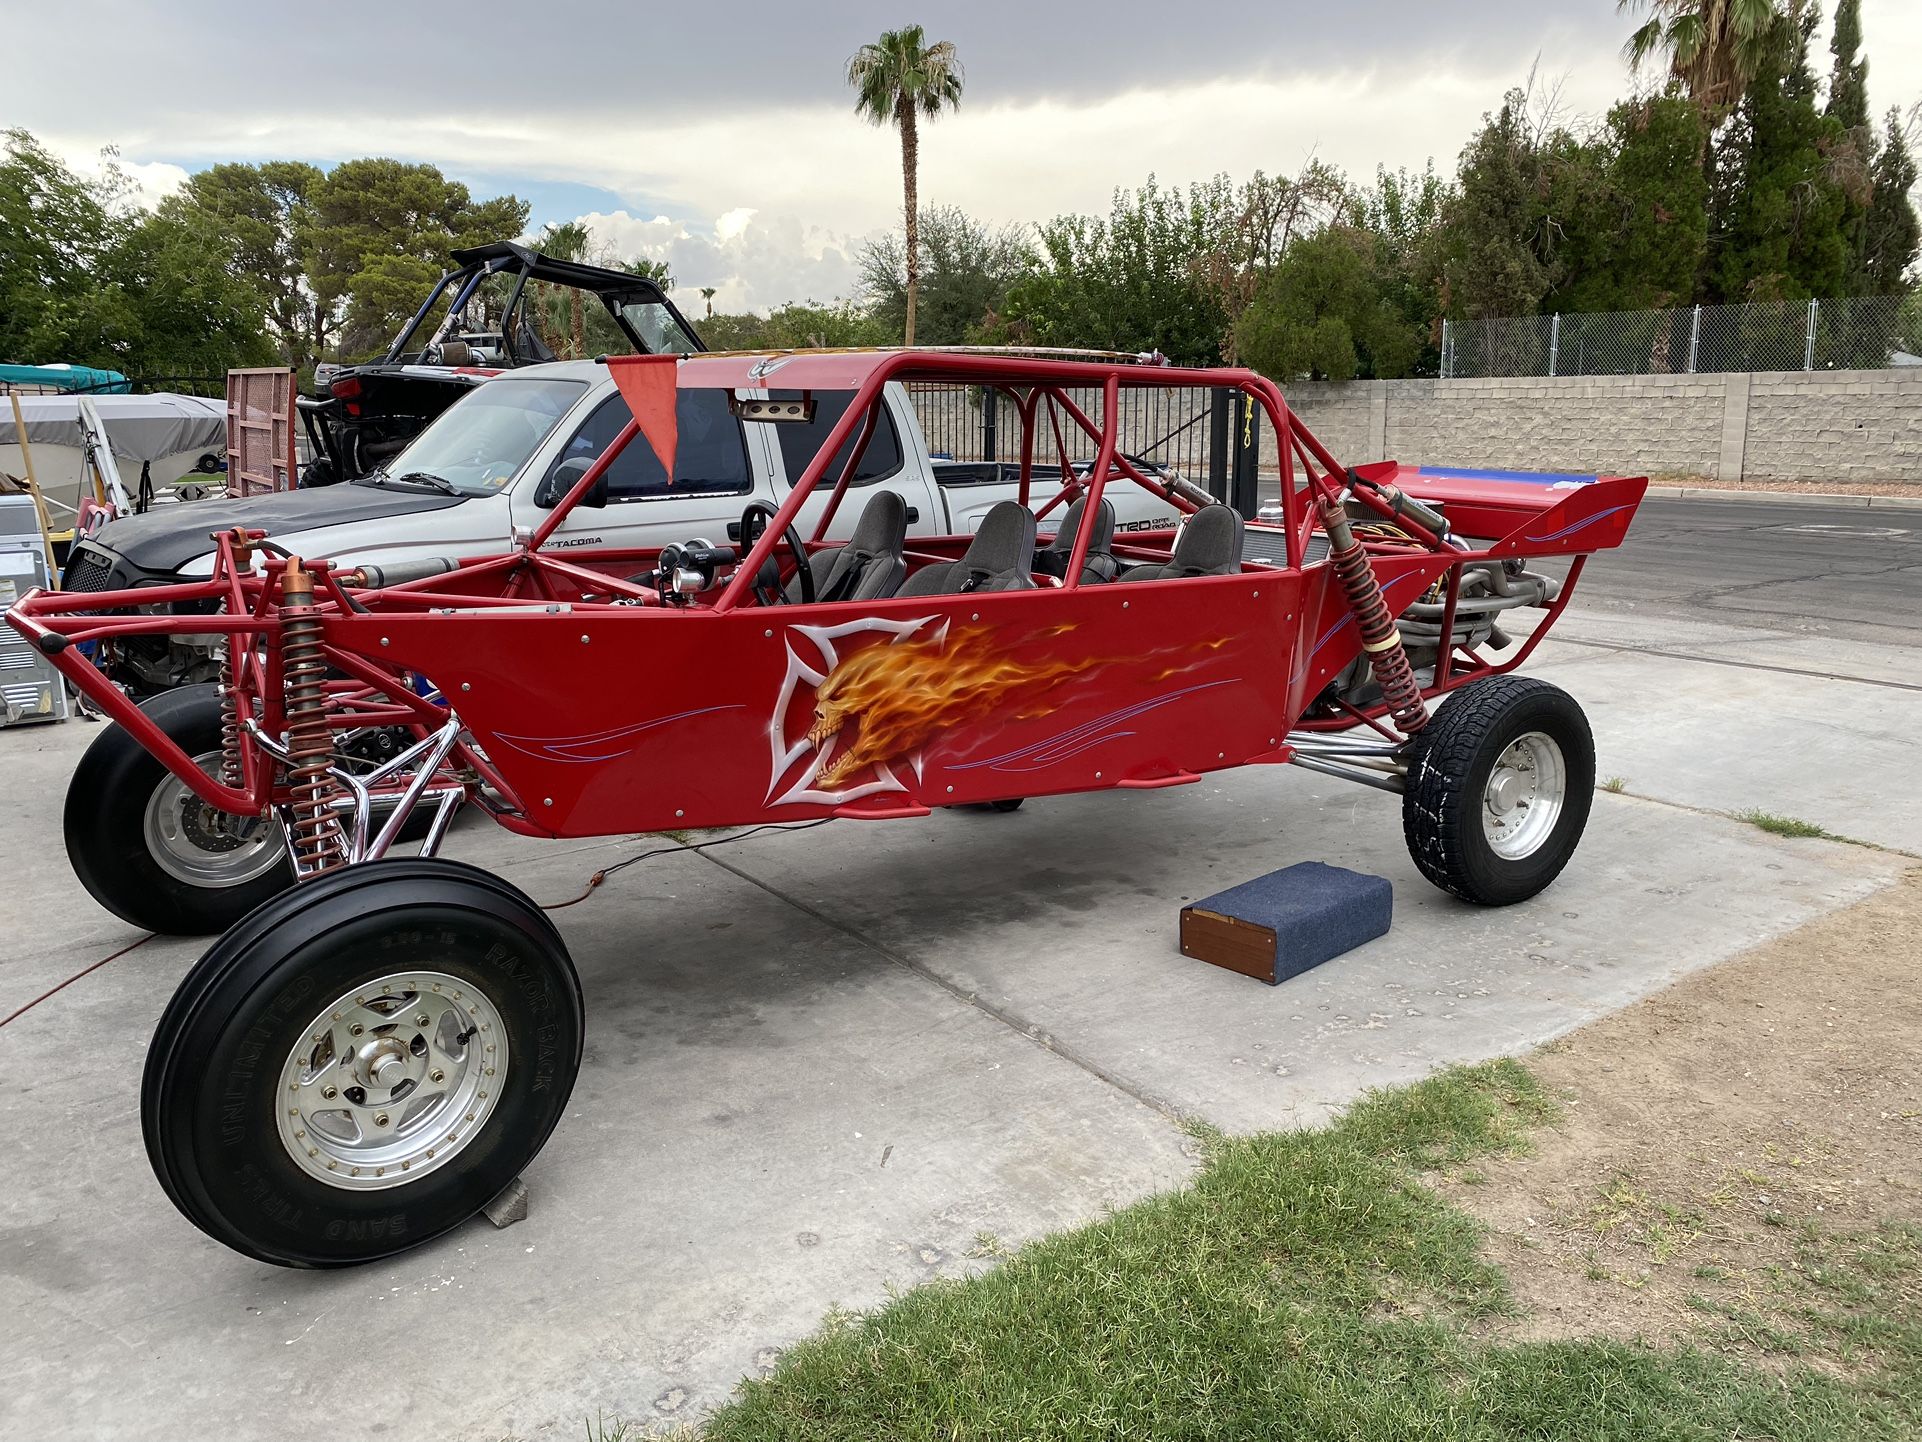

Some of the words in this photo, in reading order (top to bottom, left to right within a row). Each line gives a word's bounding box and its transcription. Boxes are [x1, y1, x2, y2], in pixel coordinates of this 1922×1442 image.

[1115, 520, 1150, 532] TRD
[1152, 522, 1176, 530] ROAD
[557, 537, 603, 548] TACOMA
[485, 942, 551, 1015] RAZOR
[533, 1023, 561, 1093] BACK
[224, 974, 319, 1147] UNLIMITED
[325, 1213, 410, 1242] SAND
